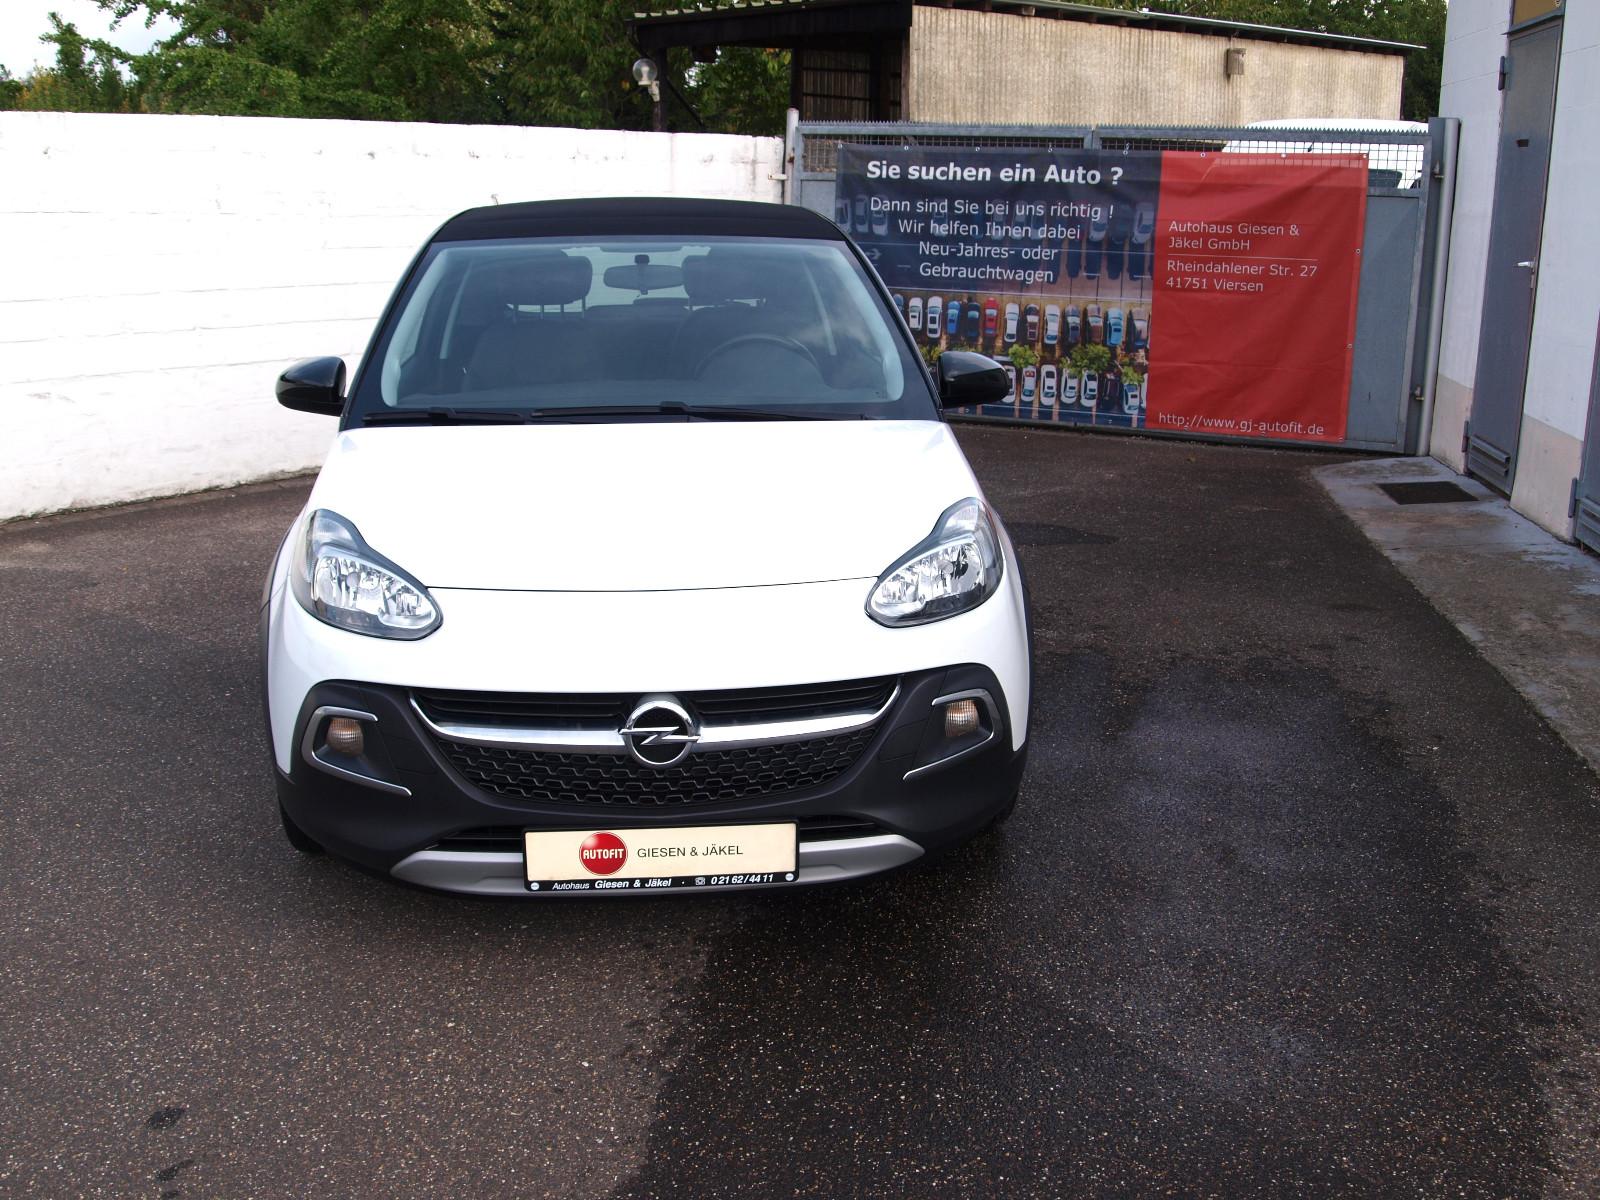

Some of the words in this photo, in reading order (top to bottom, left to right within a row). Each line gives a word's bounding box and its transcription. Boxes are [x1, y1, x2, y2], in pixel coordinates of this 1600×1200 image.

[866, 160, 901, 180] Sie
[907, 161, 991, 182] suchen
[999, 163, 1036, 183] ein
[1043, 164, 1101, 185] Auto
[1110, 166, 1124, 185] ?
[870, 196, 911, 212] Dann
[916, 198, 948, 214] sind
[953, 199, 979, 215] Sie
[985, 200, 1009, 216] bei
[1015, 203, 1044, 217] uns
[1050, 201, 1101, 220] richtig
[1108, 204, 1114, 219] !
[898, 218, 925, 234] Wir
[930, 220, 979, 236] helfen
[985, 223, 1032, 238] Ihnen
[1038, 223, 1081, 239] dabei
[1168, 220, 1233, 235] Autohaus
[1237, 222, 1284, 235] Giesen
[1289, 224, 1300, 236] &
[919, 240, 1016, 258] Neu-Jahres-
[1021, 245, 1058, 260] oder
[1168, 236, 1203, 249] Jäkel
[1207, 238, 1250, 250] GmbH
[919, 262, 1053, 284] Gebrauchtwagen
[1167, 259, 1265, 275] Rheindahlener
[1269, 264, 1294, 276] Str.
[1299, 265, 1318, 277] 27
[1166, 276, 1208, 290] 41751
[1213, 278, 1264, 292] Viersen
[1158, 412, 1324, 435] http://www.gj-autofit.de
[582, 848, 624, 860] AUTOFIT
[637, 847, 686, 858] GIESEN
[689, 846, 699, 857] &
[702, 843, 744, 857] JÄKEL
[552, 882, 590, 891] Autohaus
[594, 879, 629, 889] Giesen
[633, 879, 641, 888] &
[645, 877, 672, 888] Jäkel
